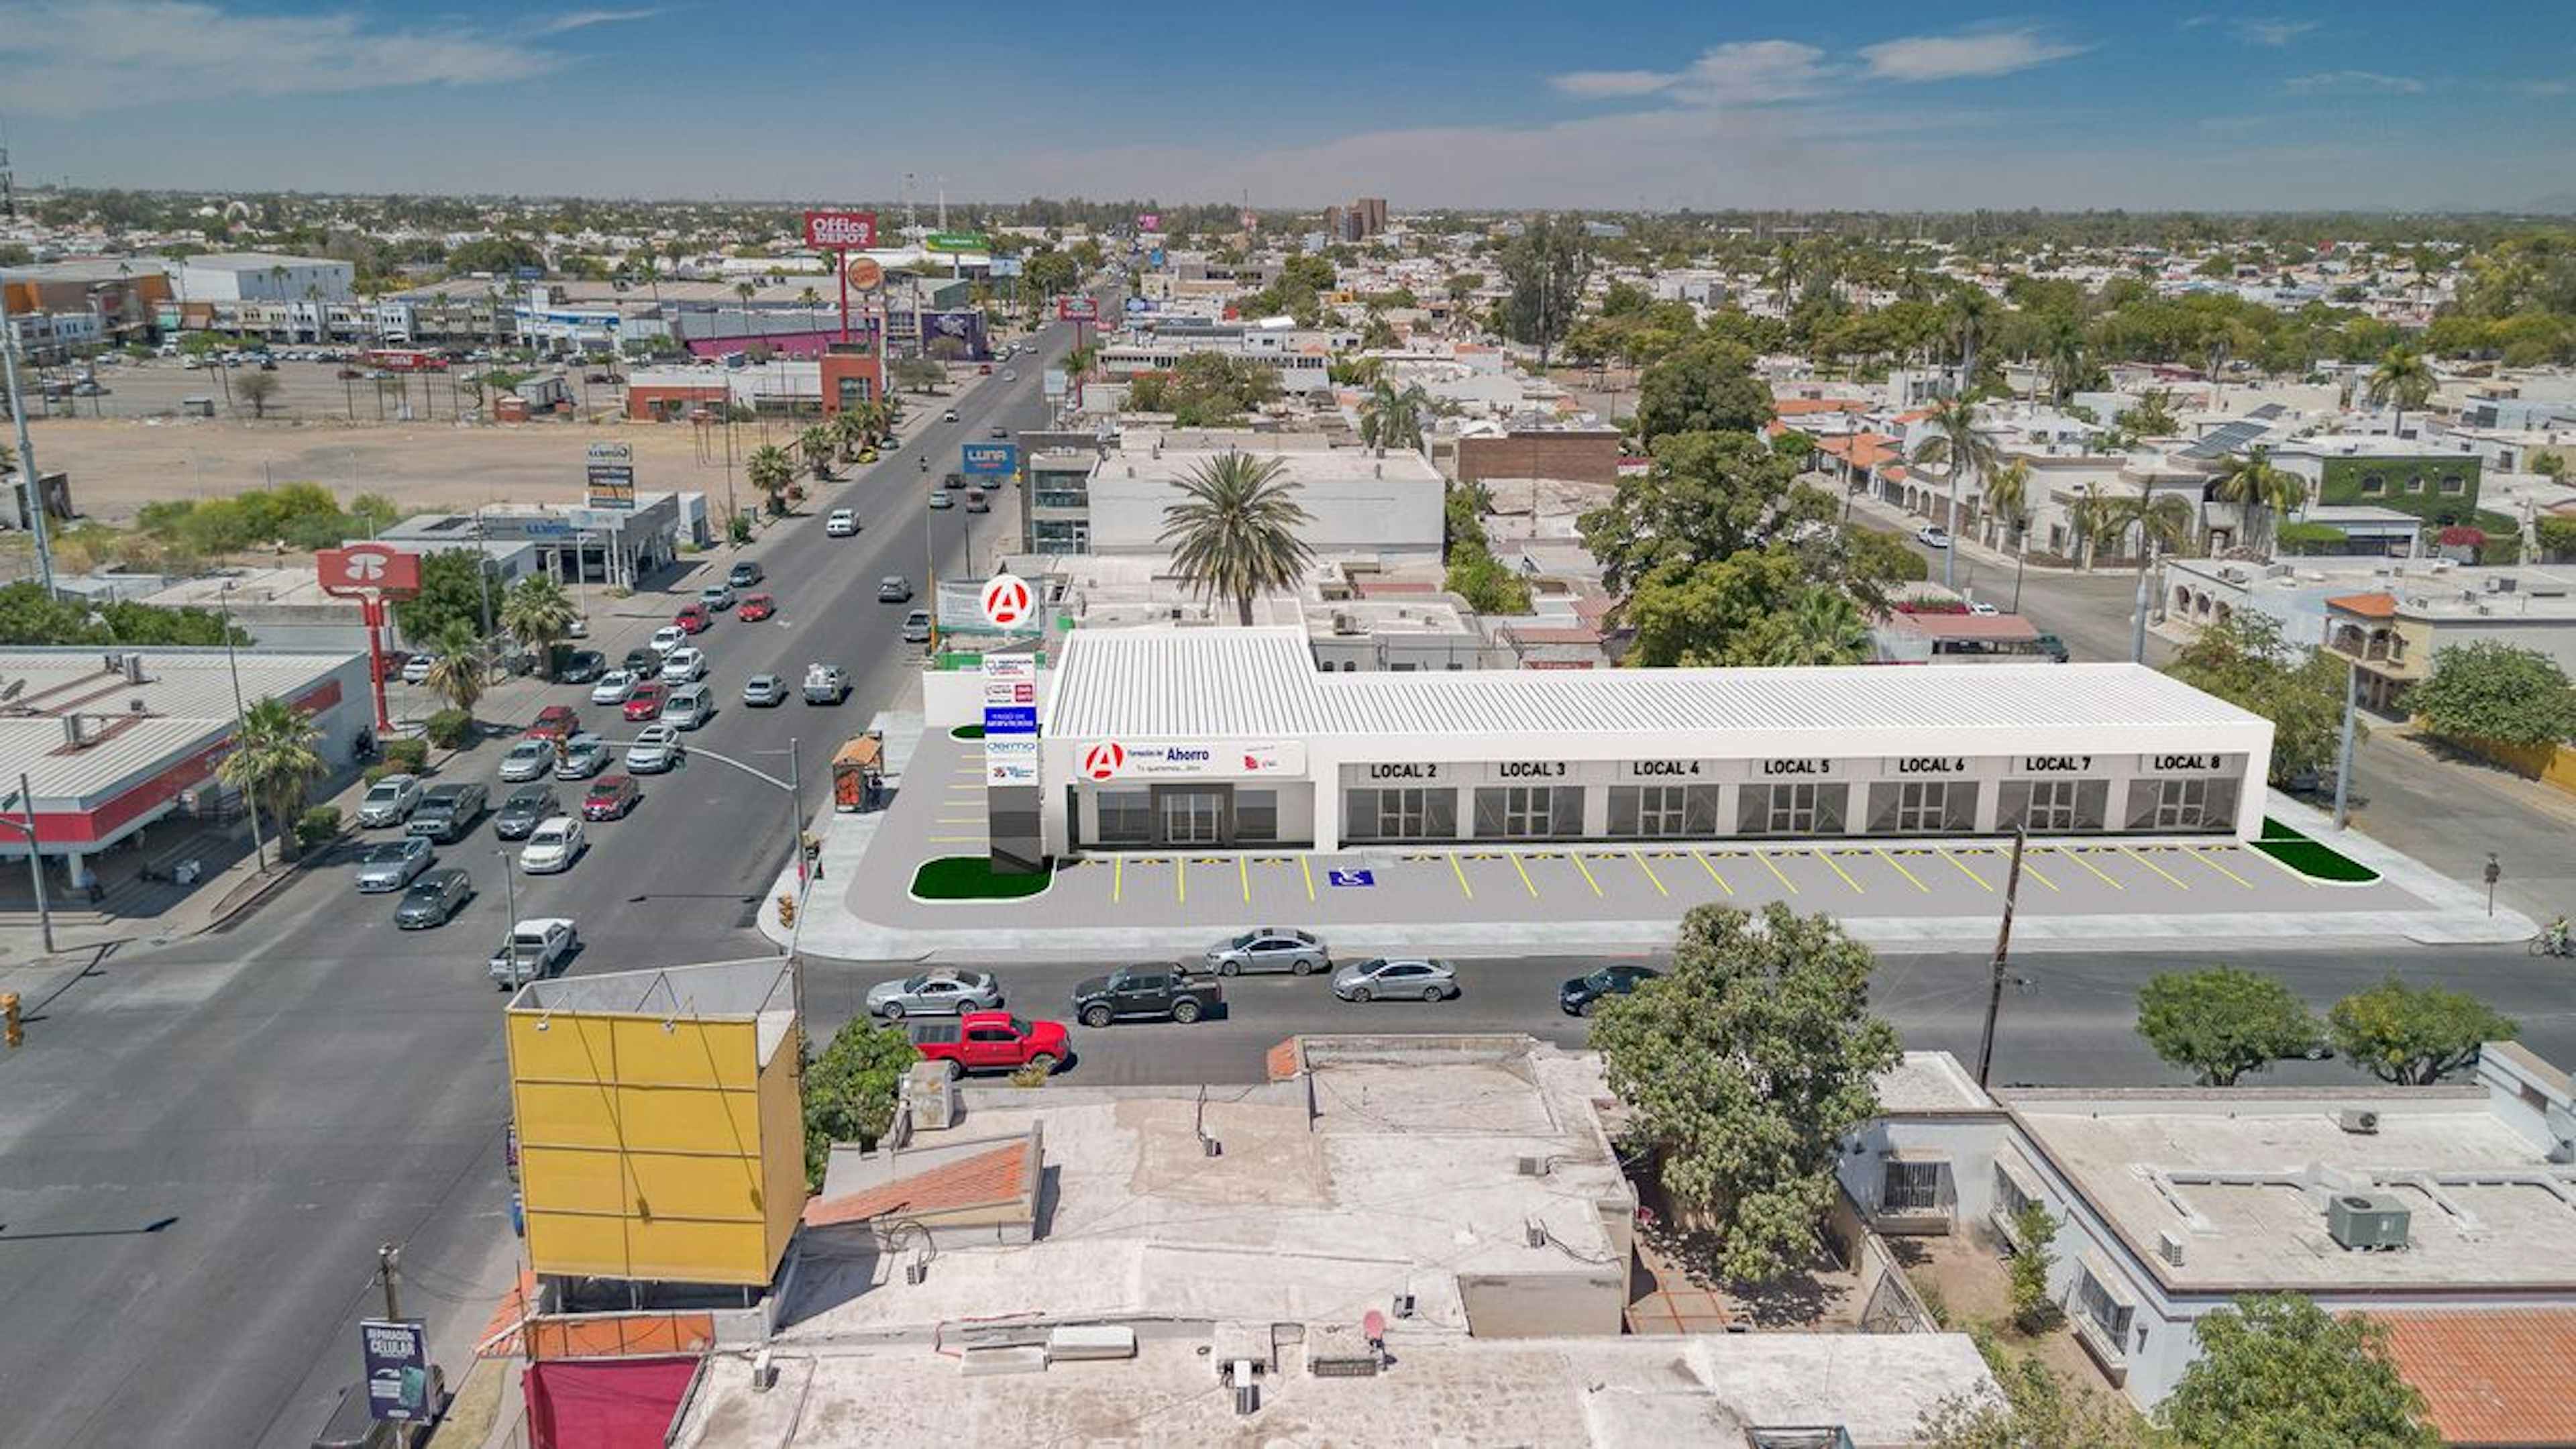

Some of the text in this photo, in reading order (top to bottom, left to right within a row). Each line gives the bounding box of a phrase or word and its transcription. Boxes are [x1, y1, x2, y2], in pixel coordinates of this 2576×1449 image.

[812, 217, 869, 234] Office
[814, 233, 869, 244] DEPOT
[1167, 747, 1210, 761] Ahorro
[1634, 761, 1699, 775] LOCAL 4
[1765, 759, 1829, 774] LOCAL 5
[1900, 757, 1964, 772] LOCAL 6
[2027, 756, 2091, 771] LOCAL 7
[2155, 755, 2220, 769] LOCAL 8
[1372, 763, 1436, 778] LOCAL 2
[1501, 763, 1565, 777] LOCAL 3
